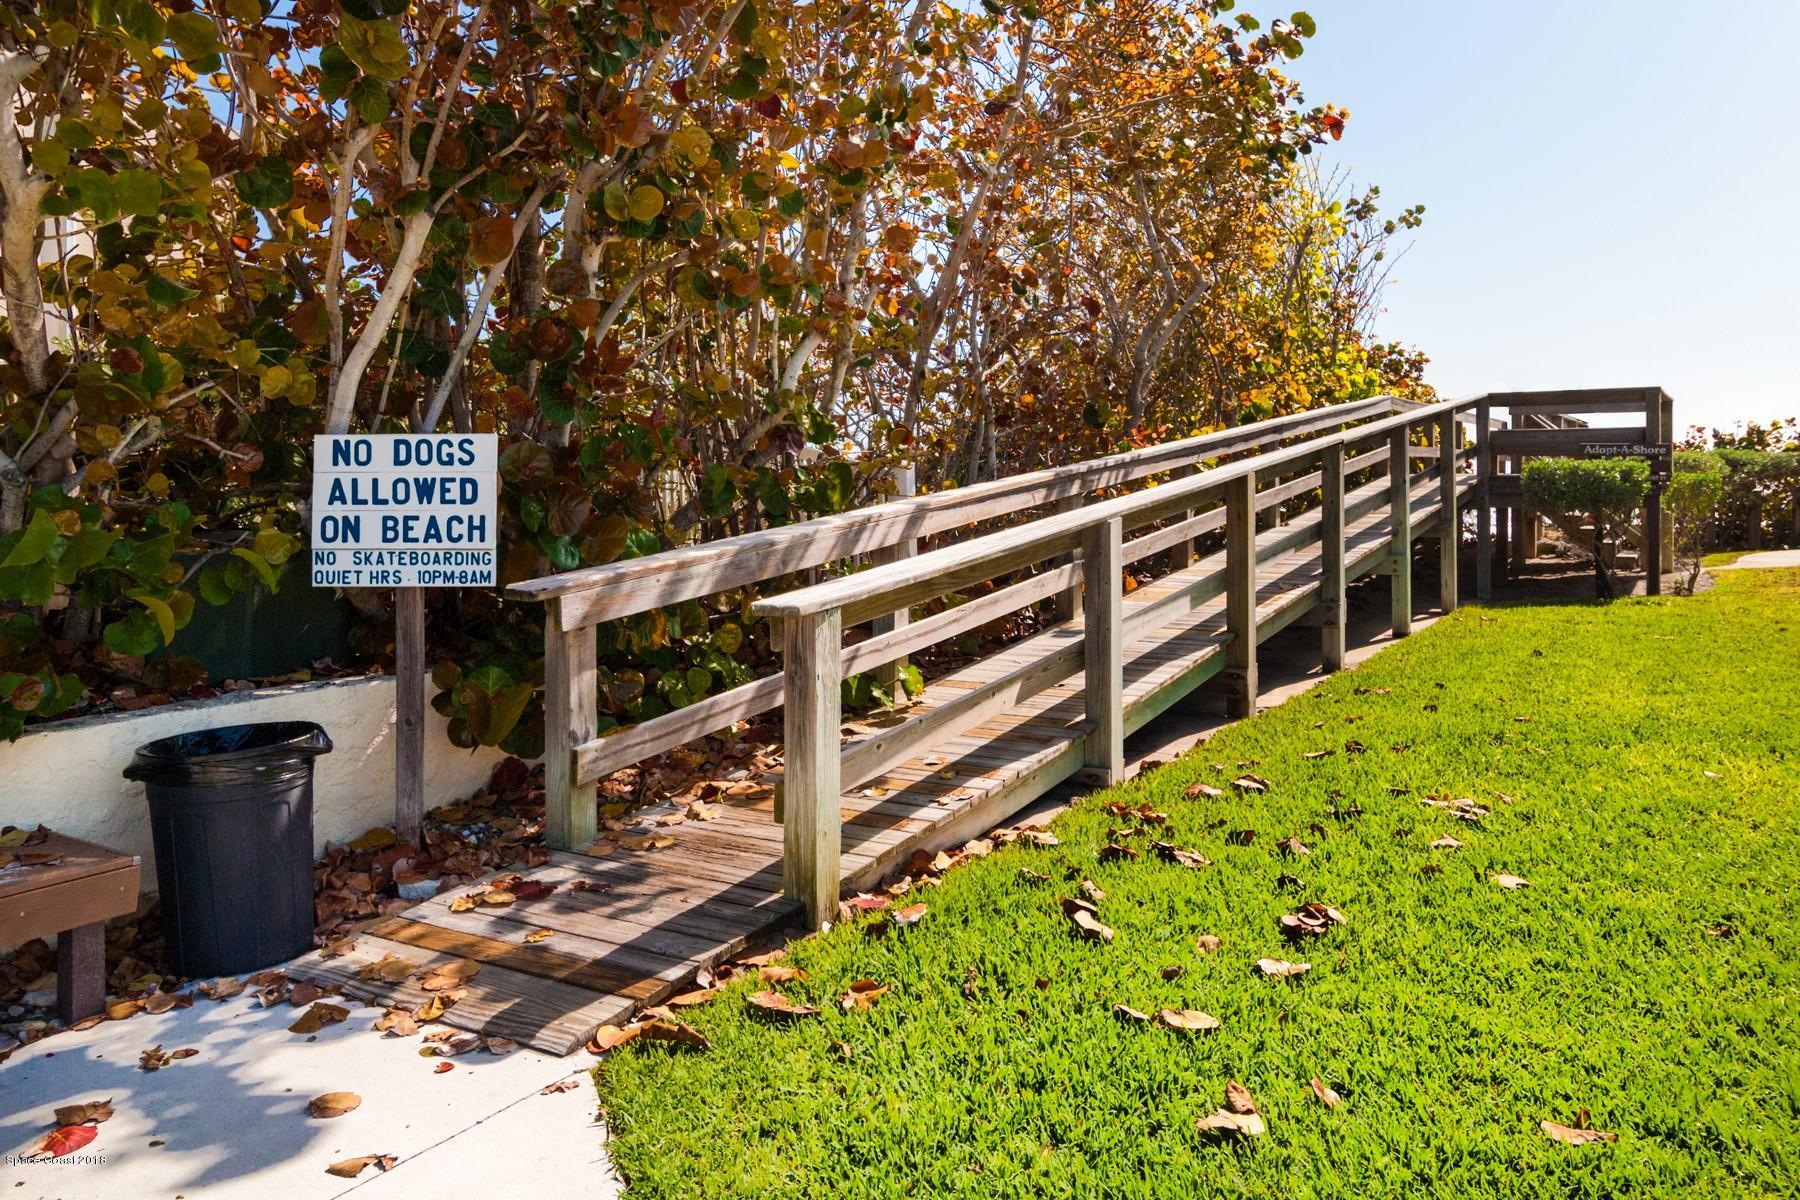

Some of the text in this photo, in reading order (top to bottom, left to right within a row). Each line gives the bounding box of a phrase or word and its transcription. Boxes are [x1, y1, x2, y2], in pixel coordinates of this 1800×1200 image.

[332, 439, 475, 467] NO DOGS
[1583, 445, 1667, 456] Adopt-A-Shore
[328, 477, 479, 506] ALLOWED
[320, 515, 486, 544] ON BEACH
[314, 551, 492, 566] NO SKATEBOARDING
[314, 570, 492, 585] QUIET HRS 10PM-8AM
